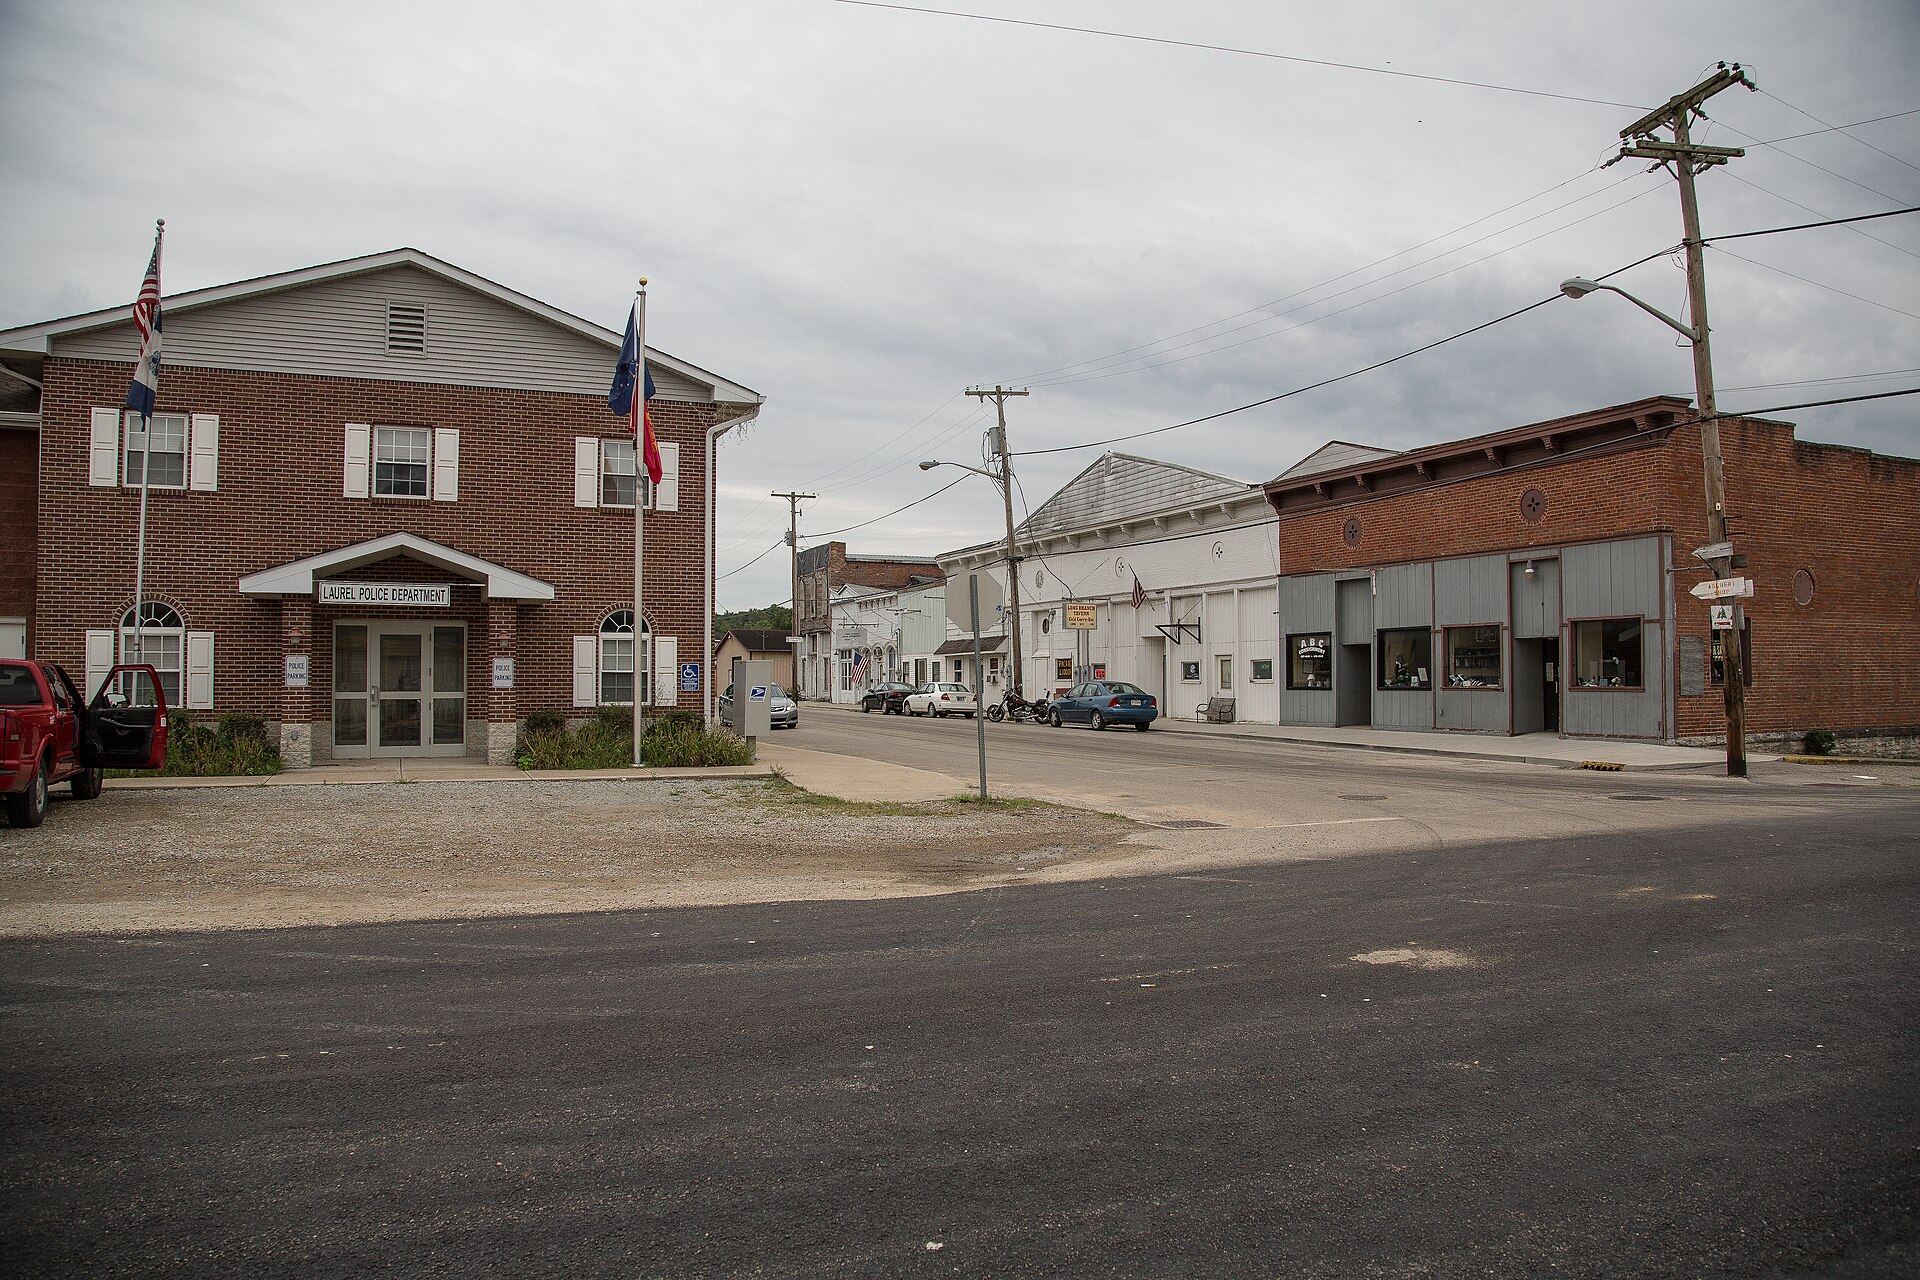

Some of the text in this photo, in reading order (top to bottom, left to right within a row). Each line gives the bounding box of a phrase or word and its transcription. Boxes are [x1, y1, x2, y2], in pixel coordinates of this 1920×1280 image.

[323, 586, 446, 602] LAUREL POLICE DEPARTMENT
[288, 662, 305, 670] POLICE
[495, 664, 511, 672] POLICE
